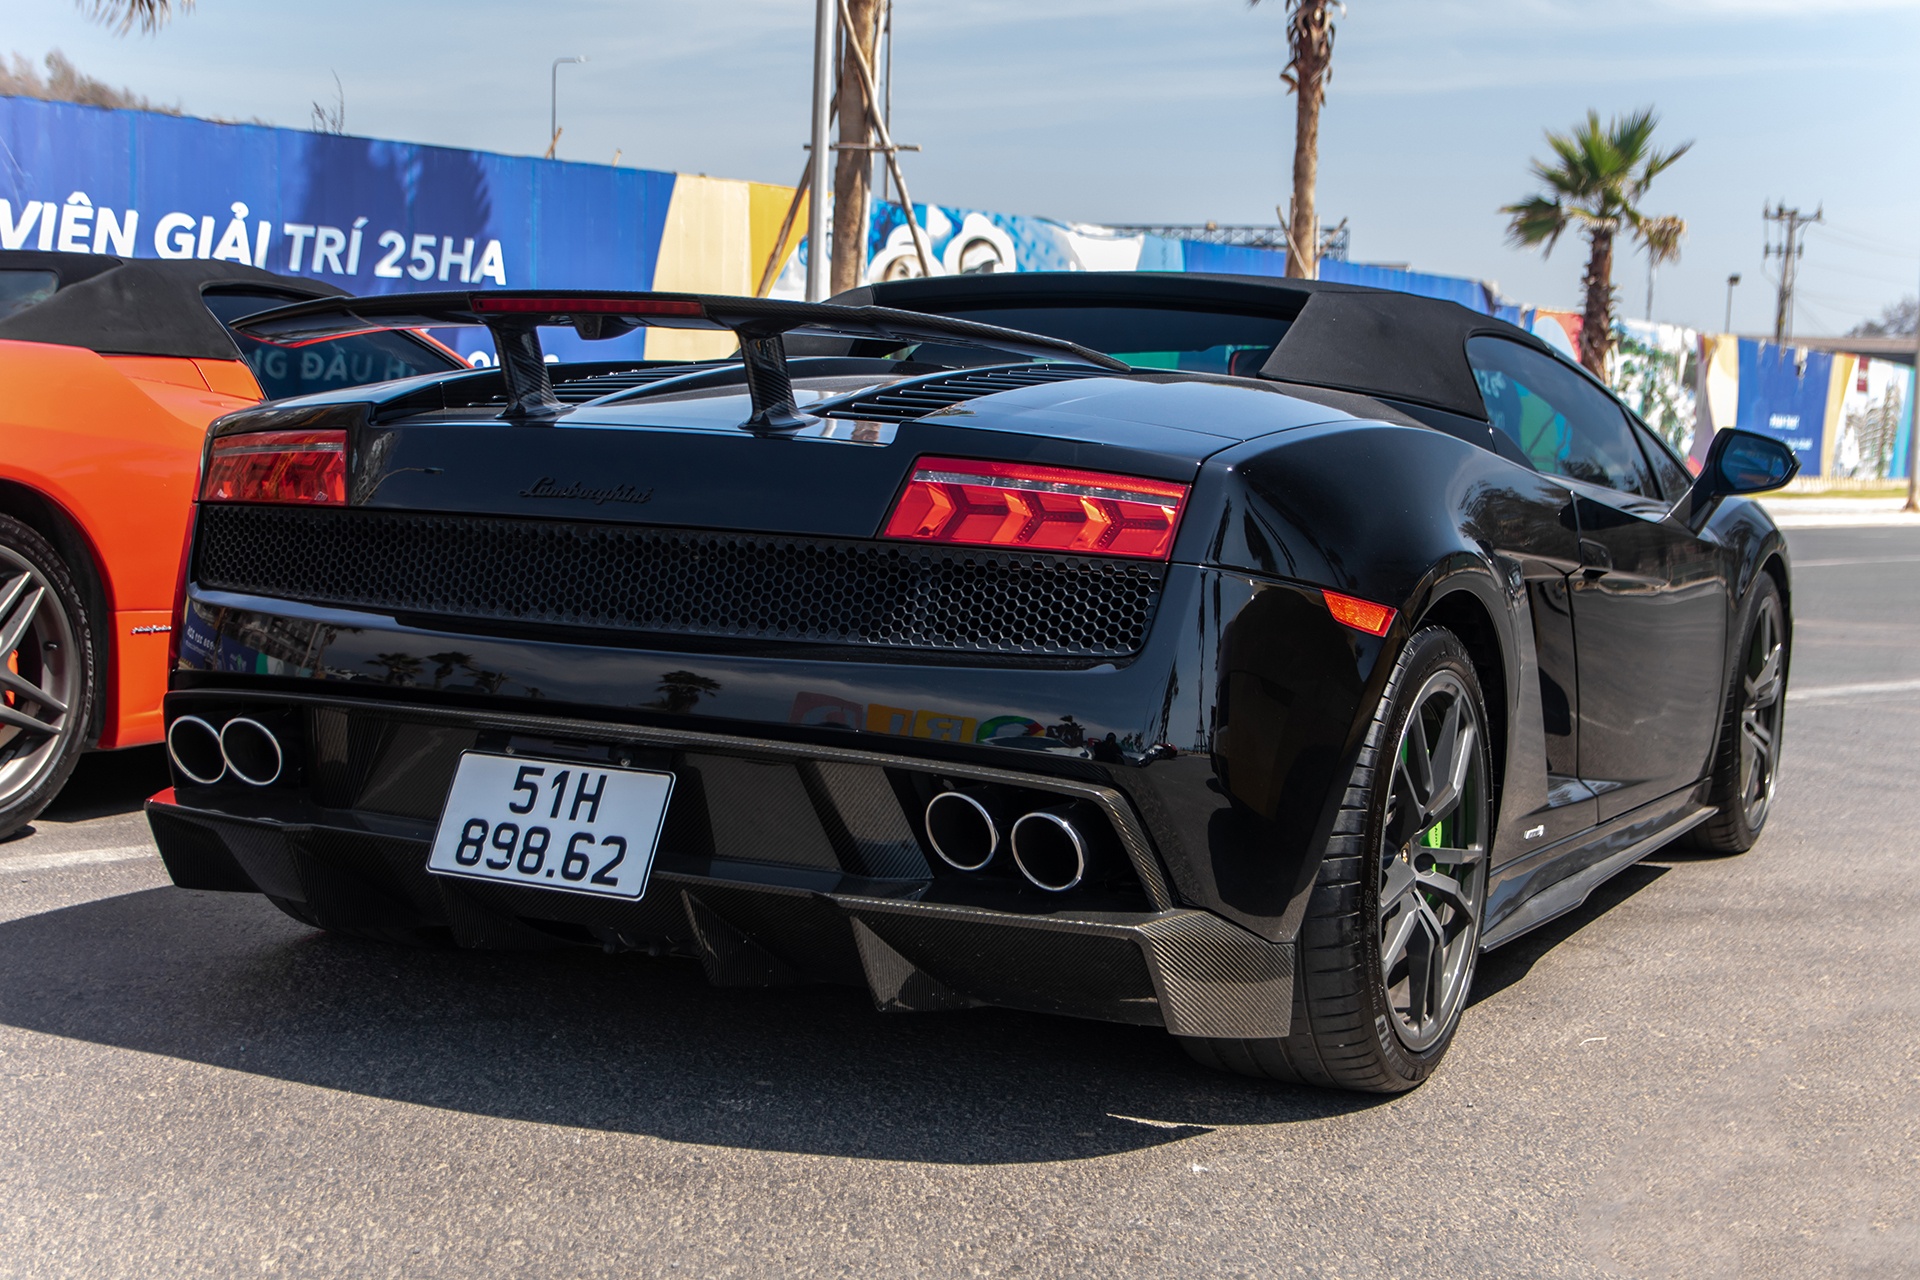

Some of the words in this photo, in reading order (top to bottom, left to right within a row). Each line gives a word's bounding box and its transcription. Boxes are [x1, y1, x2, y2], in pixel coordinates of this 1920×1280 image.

[0, 191, 139, 258] VIÊN
[154, 202, 272, 270] GIẢI
[284, 216, 369, 275] TRÍ
[374, 230, 507, 286] 25HA
[518, 476, 655, 506] Lamborghini
[509, 766, 607, 823] 51H
[455, 818, 628, 887] 898.62
